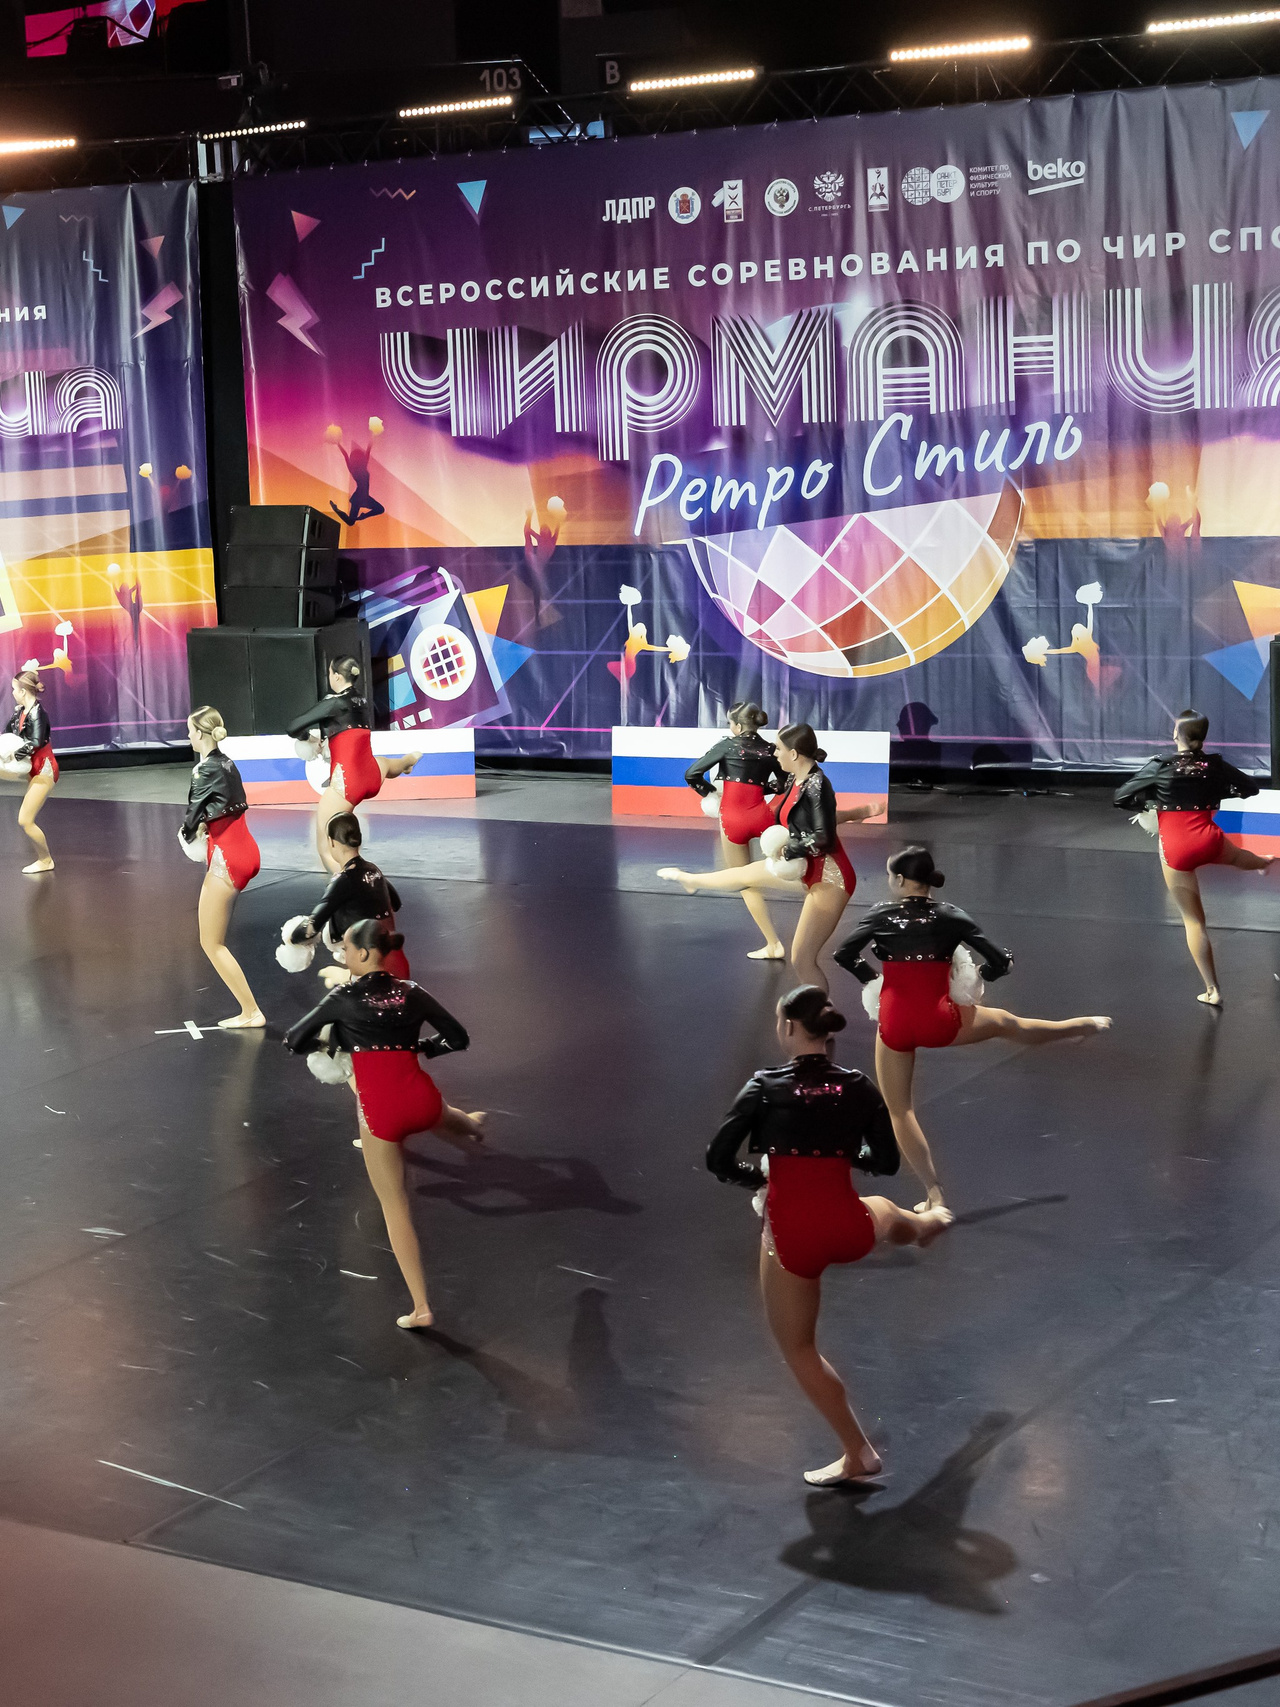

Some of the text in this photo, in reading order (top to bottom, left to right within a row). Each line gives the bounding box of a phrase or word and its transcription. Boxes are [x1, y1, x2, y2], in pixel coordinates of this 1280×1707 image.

[479, 67, 521, 92] 103
[969, 165, 998, 173] КОМИТЕТ
[1027, 157, 1086, 181] beko
[976, 189, 1001, 197] СПОРТУ
[602, 196, 656, 224] ЛДПР
[375, 267, 670, 308] ВСЕРОССИЙСКИЕ
[687, 243, 1005, 288] СОРЕВНОВАНИЯ
[1027, 239, 1081, 265] ПО
[1102, 232, 1187, 260] ЧИР
[633, 411, 1083, 536] Ретро Стиль
